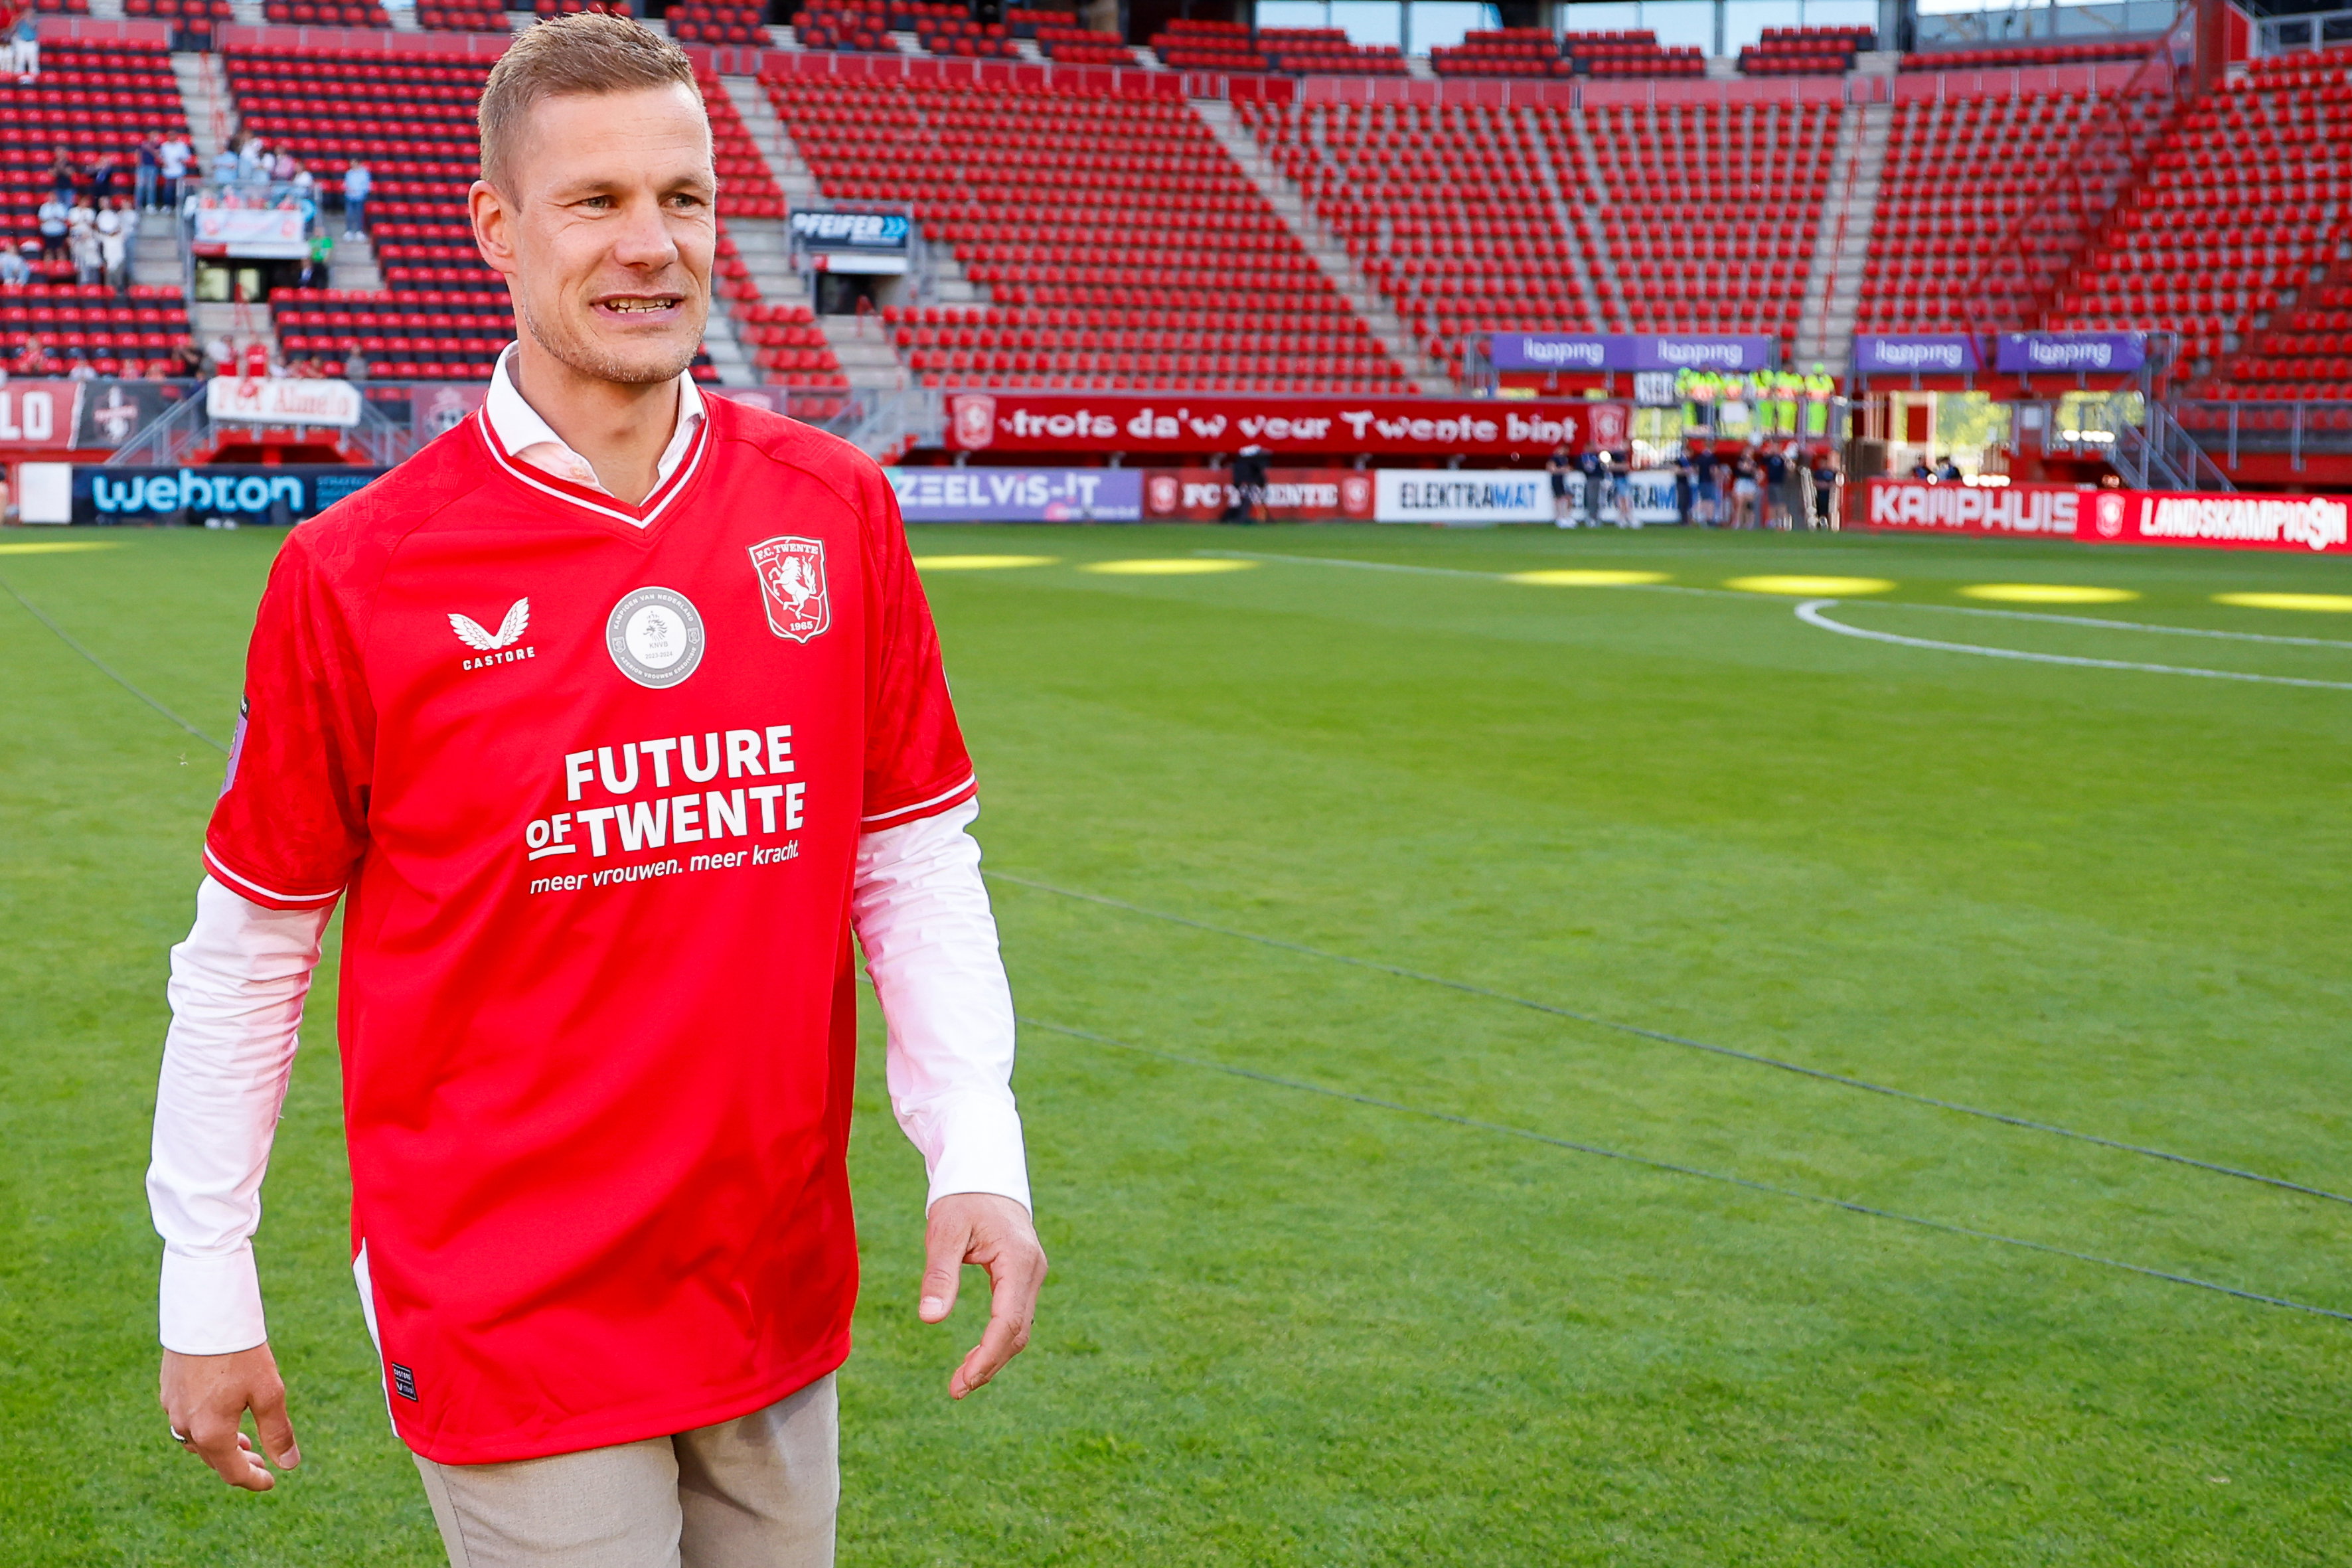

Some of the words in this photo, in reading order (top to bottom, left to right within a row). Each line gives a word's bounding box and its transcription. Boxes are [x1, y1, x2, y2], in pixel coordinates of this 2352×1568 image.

[793, 213, 884, 239] PFEIFER
[1012, 408, 1118, 438] trots
[1127, 408, 1227, 439] da'w
[1237, 414, 1332, 439] veur
[1339, 410, 1499, 443] Twente
[1506, 412, 1578, 445] bint
[92, 468, 303, 512] webton
[1183, 483, 1221, 508] FC
[1871, 485, 2079, 533] KAMPHUIS
[755, 547, 774, 560] F.C.
[773, 543, 819, 555] TWENTE
[613, 598, 639, 630] KAMPIOEN
[657, 593, 694, 622] NEDERLAND
[790, 621, 813, 631] 1965
[463, 646, 535, 670] CASTORE
[620, 656, 643, 675] AZERION
[674, 647, 696, 674] EREDIVISIE
[565, 724, 795, 801] FUTURE
[525, 813, 572, 848] OF
[576, 781, 807, 858] TWENTE
[530, 874, 588, 894] meer
[593, 859, 683, 888] vrouwen.
[690, 850, 747, 872] meer
